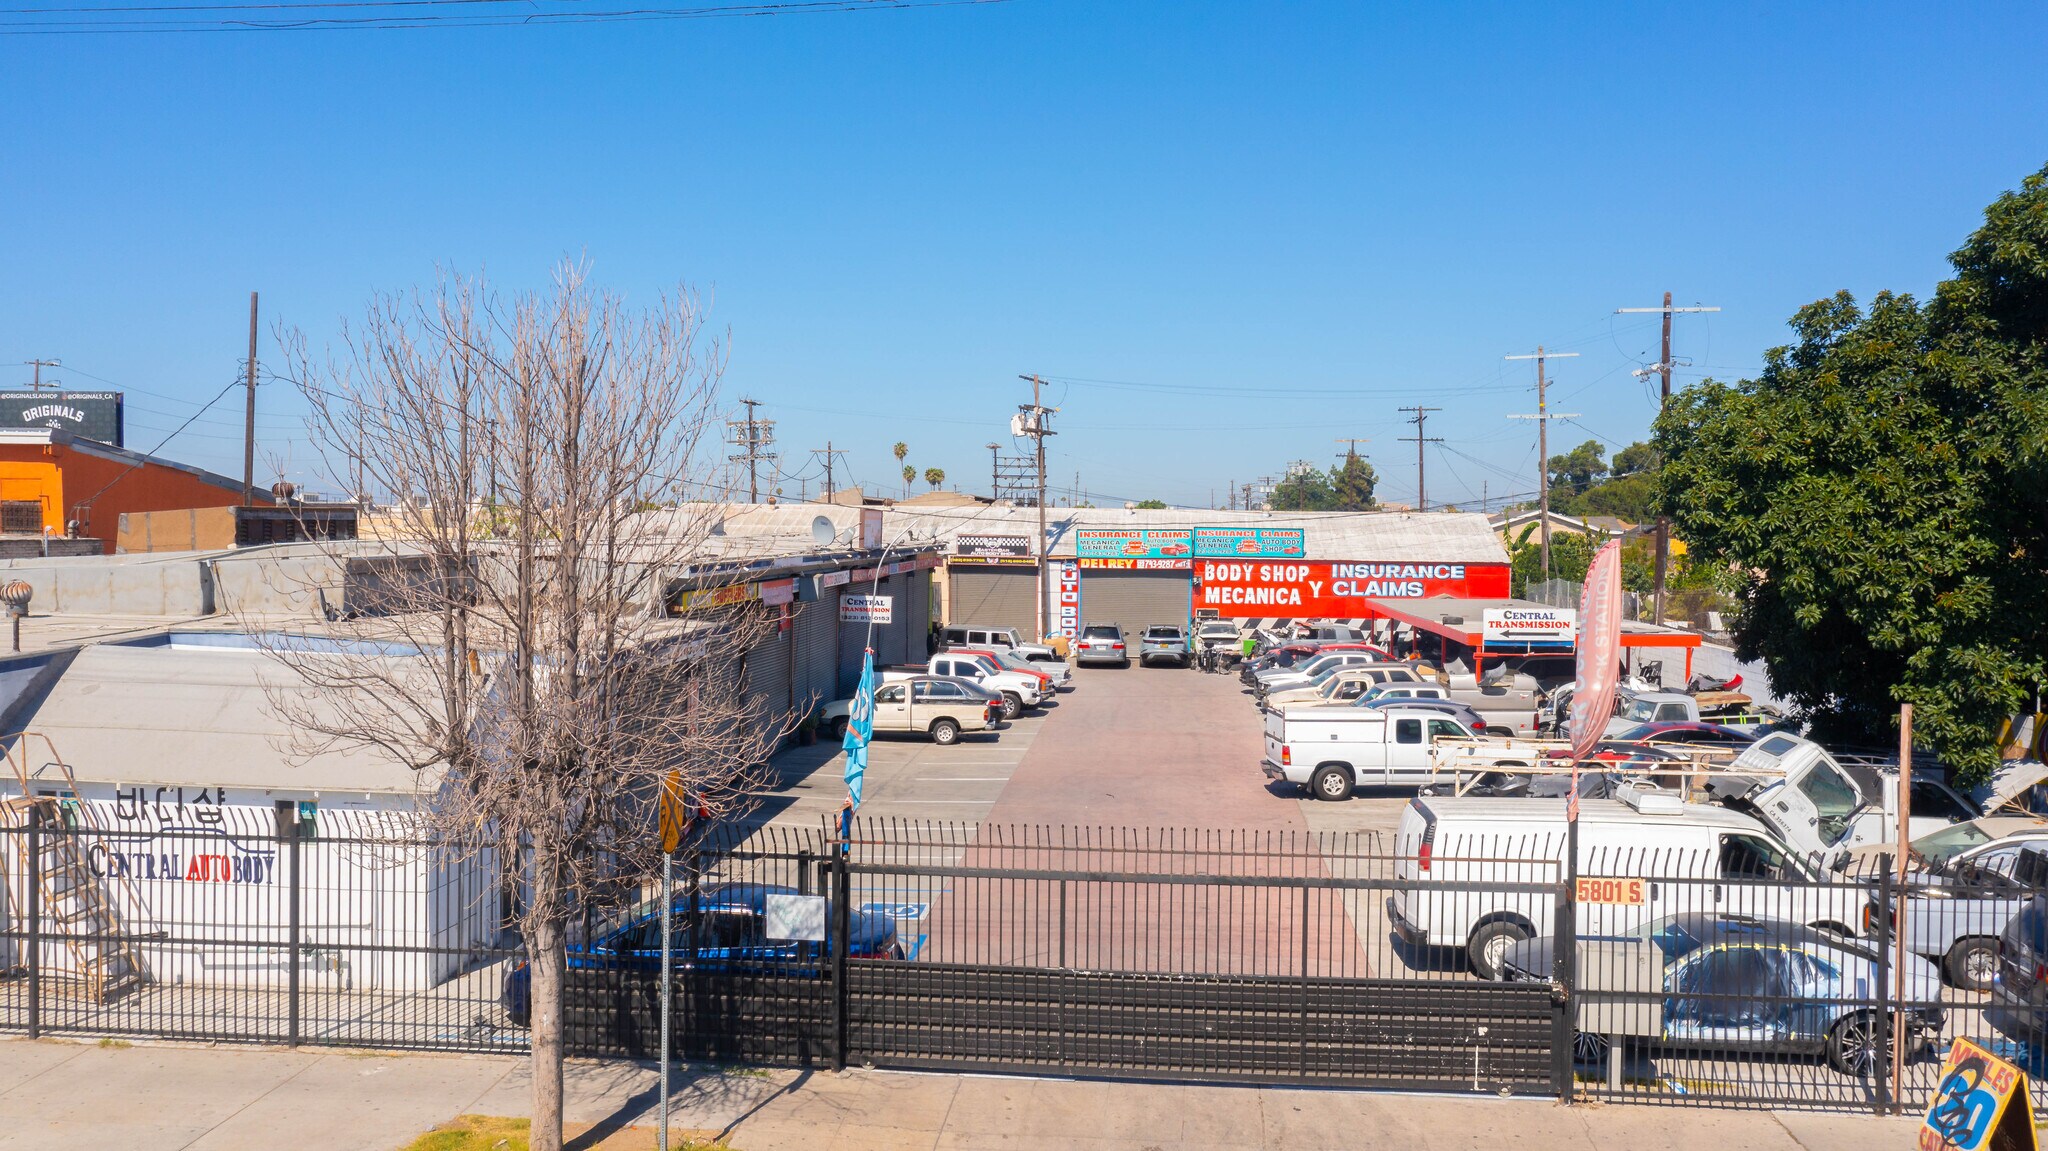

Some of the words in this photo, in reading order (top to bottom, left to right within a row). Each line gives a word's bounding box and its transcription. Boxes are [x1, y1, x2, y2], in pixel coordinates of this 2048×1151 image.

[22, 404, 85, 423] ORIGINALS
[1080, 559, 1106, 569] DEL
[1108, 559, 1134, 569] REY
[1144, 559, 1175, 568] 743-9287
[1331, 564, 1465, 579] INSURANCE
[1205, 564, 1254, 581] BODY
[1260, 565, 1310, 582] SHOP
[1205, 587, 1302, 605] MECANICA
[1308, 581, 1323, 598] Y
[1332, 581, 1424, 597] CLAIMS
[1503, 610, 1556, 620] CENTRAL
[1595, 567, 1609, 649] STATION
[1061, 606, 1077, 639] BOD
[1488, 620, 1571, 629] TRANSMISSION
[116, 787, 226, 824] 바디샵
[90, 844, 184, 880] CENTRAL
[1578, 880, 1622, 902] 5801
[1629, 882, 1645, 903] S.
